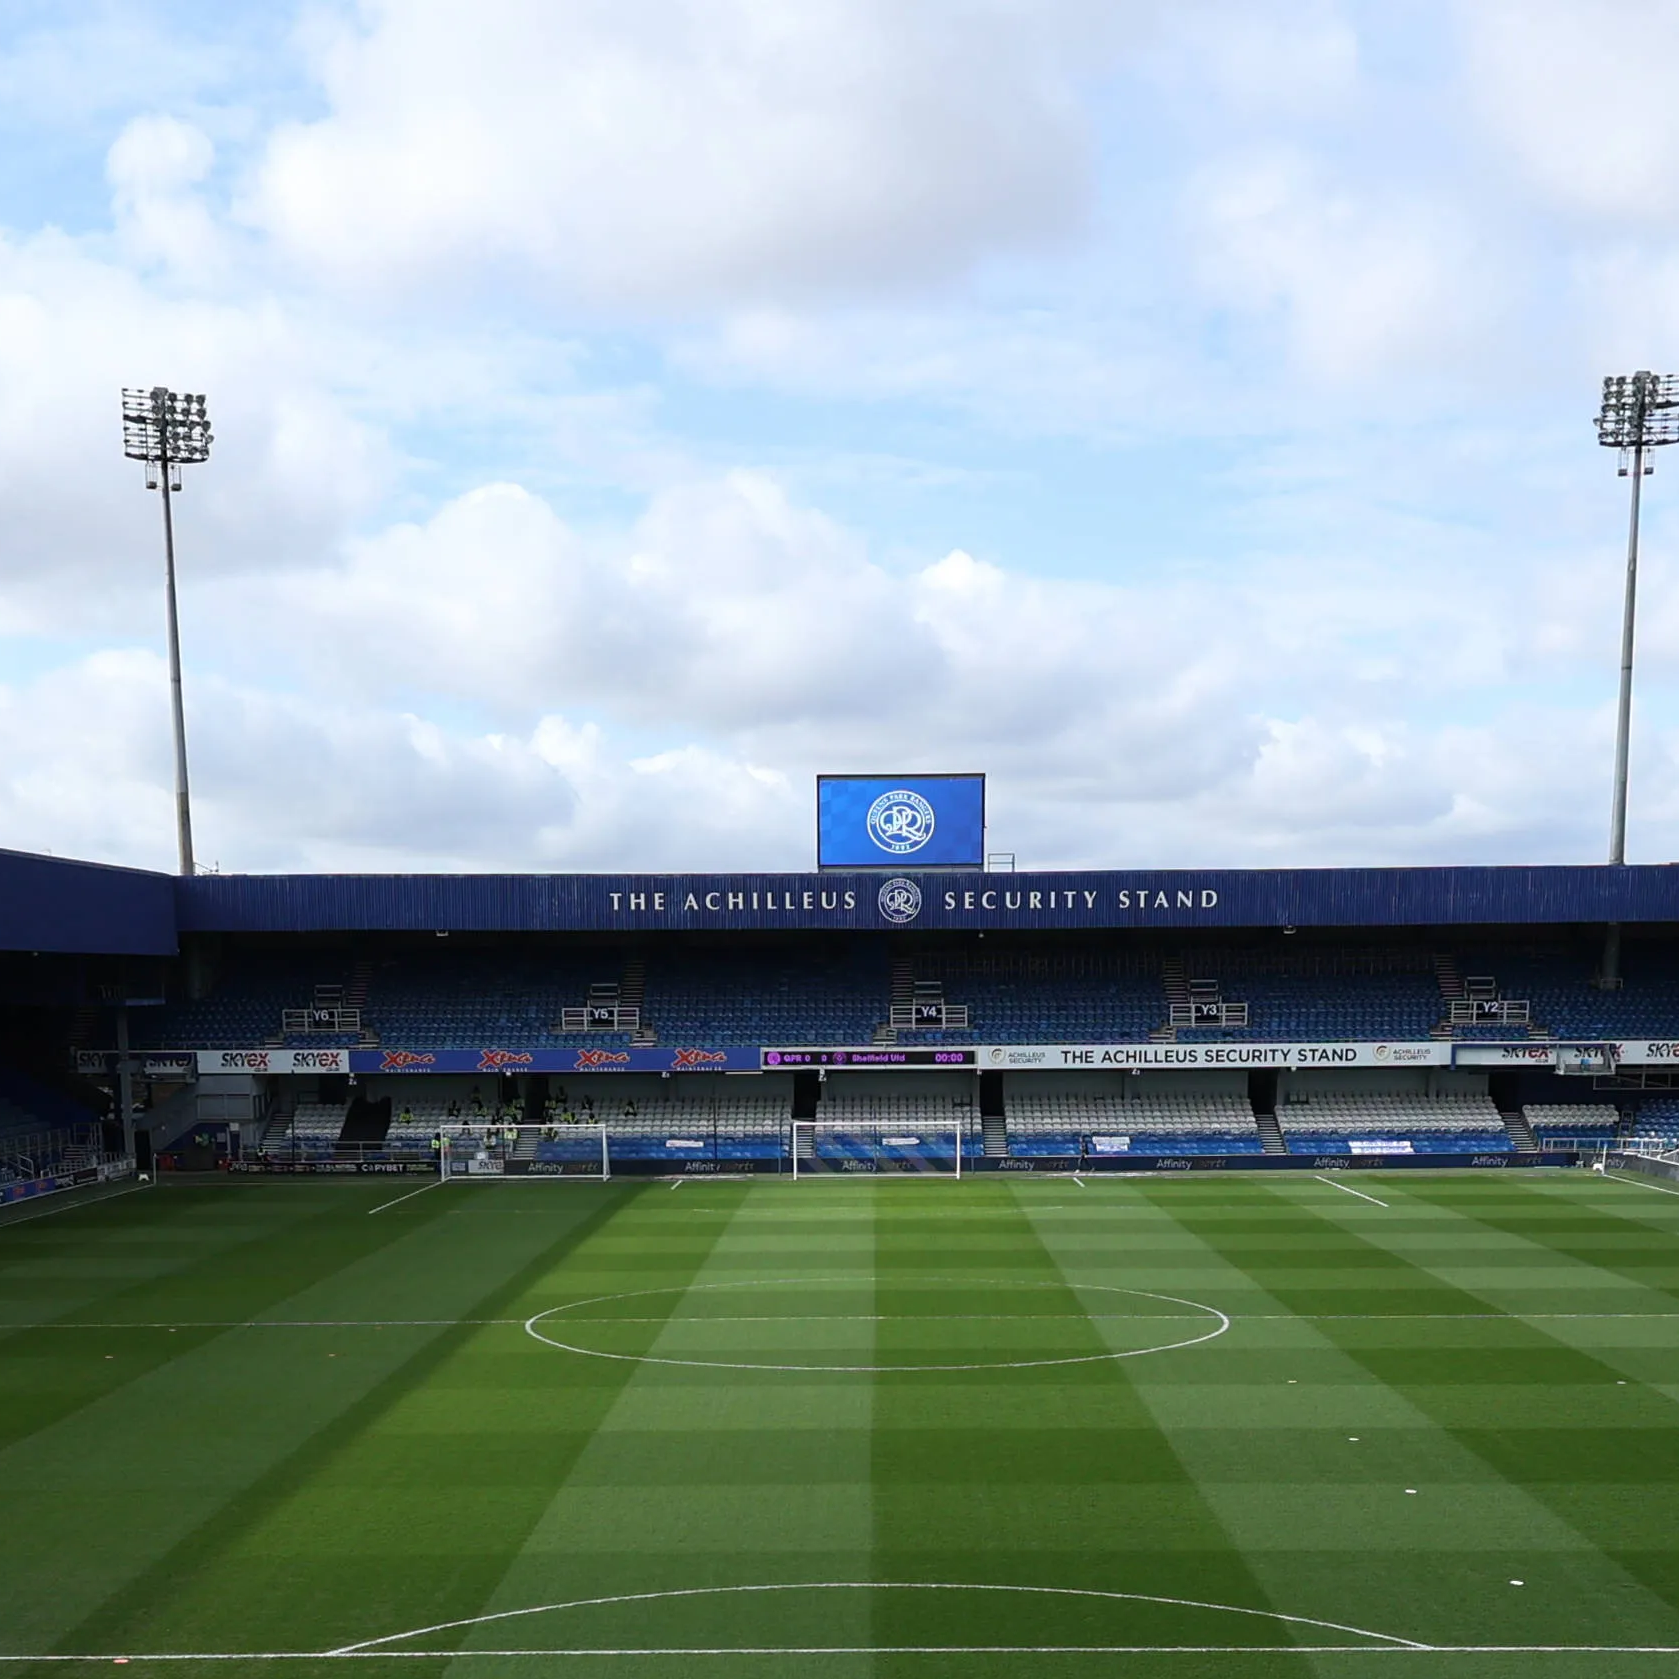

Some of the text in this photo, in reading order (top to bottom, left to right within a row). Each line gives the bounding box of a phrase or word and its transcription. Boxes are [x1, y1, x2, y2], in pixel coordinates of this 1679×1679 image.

[610, 892, 666, 911] THE
[684, 891, 857, 911] ACHILLEUS
[945, 890, 1098, 911] SECURITY
[1120, 889, 1220, 910] STAND
[921, 1006, 937, 1017] Y4
[1201, 1004, 1217, 1015] Y3
[1483, 1001, 1499, 1012] Y2
[313, 1009, 330, 1021] Y6
[592, 1008, 608, 1020] Y5
[784, 1054, 802, 1062] QPR
[852, 1053, 888, 1062] Sheffield
[935, 1053, 964, 1062] 00:00
[1060, 1047, 1357, 1064] THE ACHILLEUS SECURITY STAND
[684, 1161, 721, 1173] Affinity
[841, 1160, 877, 1171] Affinity
[998, 1160, 1035, 1172] Affinity
[1156, 1159, 1192, 1171] Affinity
[1313, 1157, 1350, 1169] Affinity
[1471, 1156, 1508, 1168] Affinity
[528, 1162, 563, 1175] Affinity
